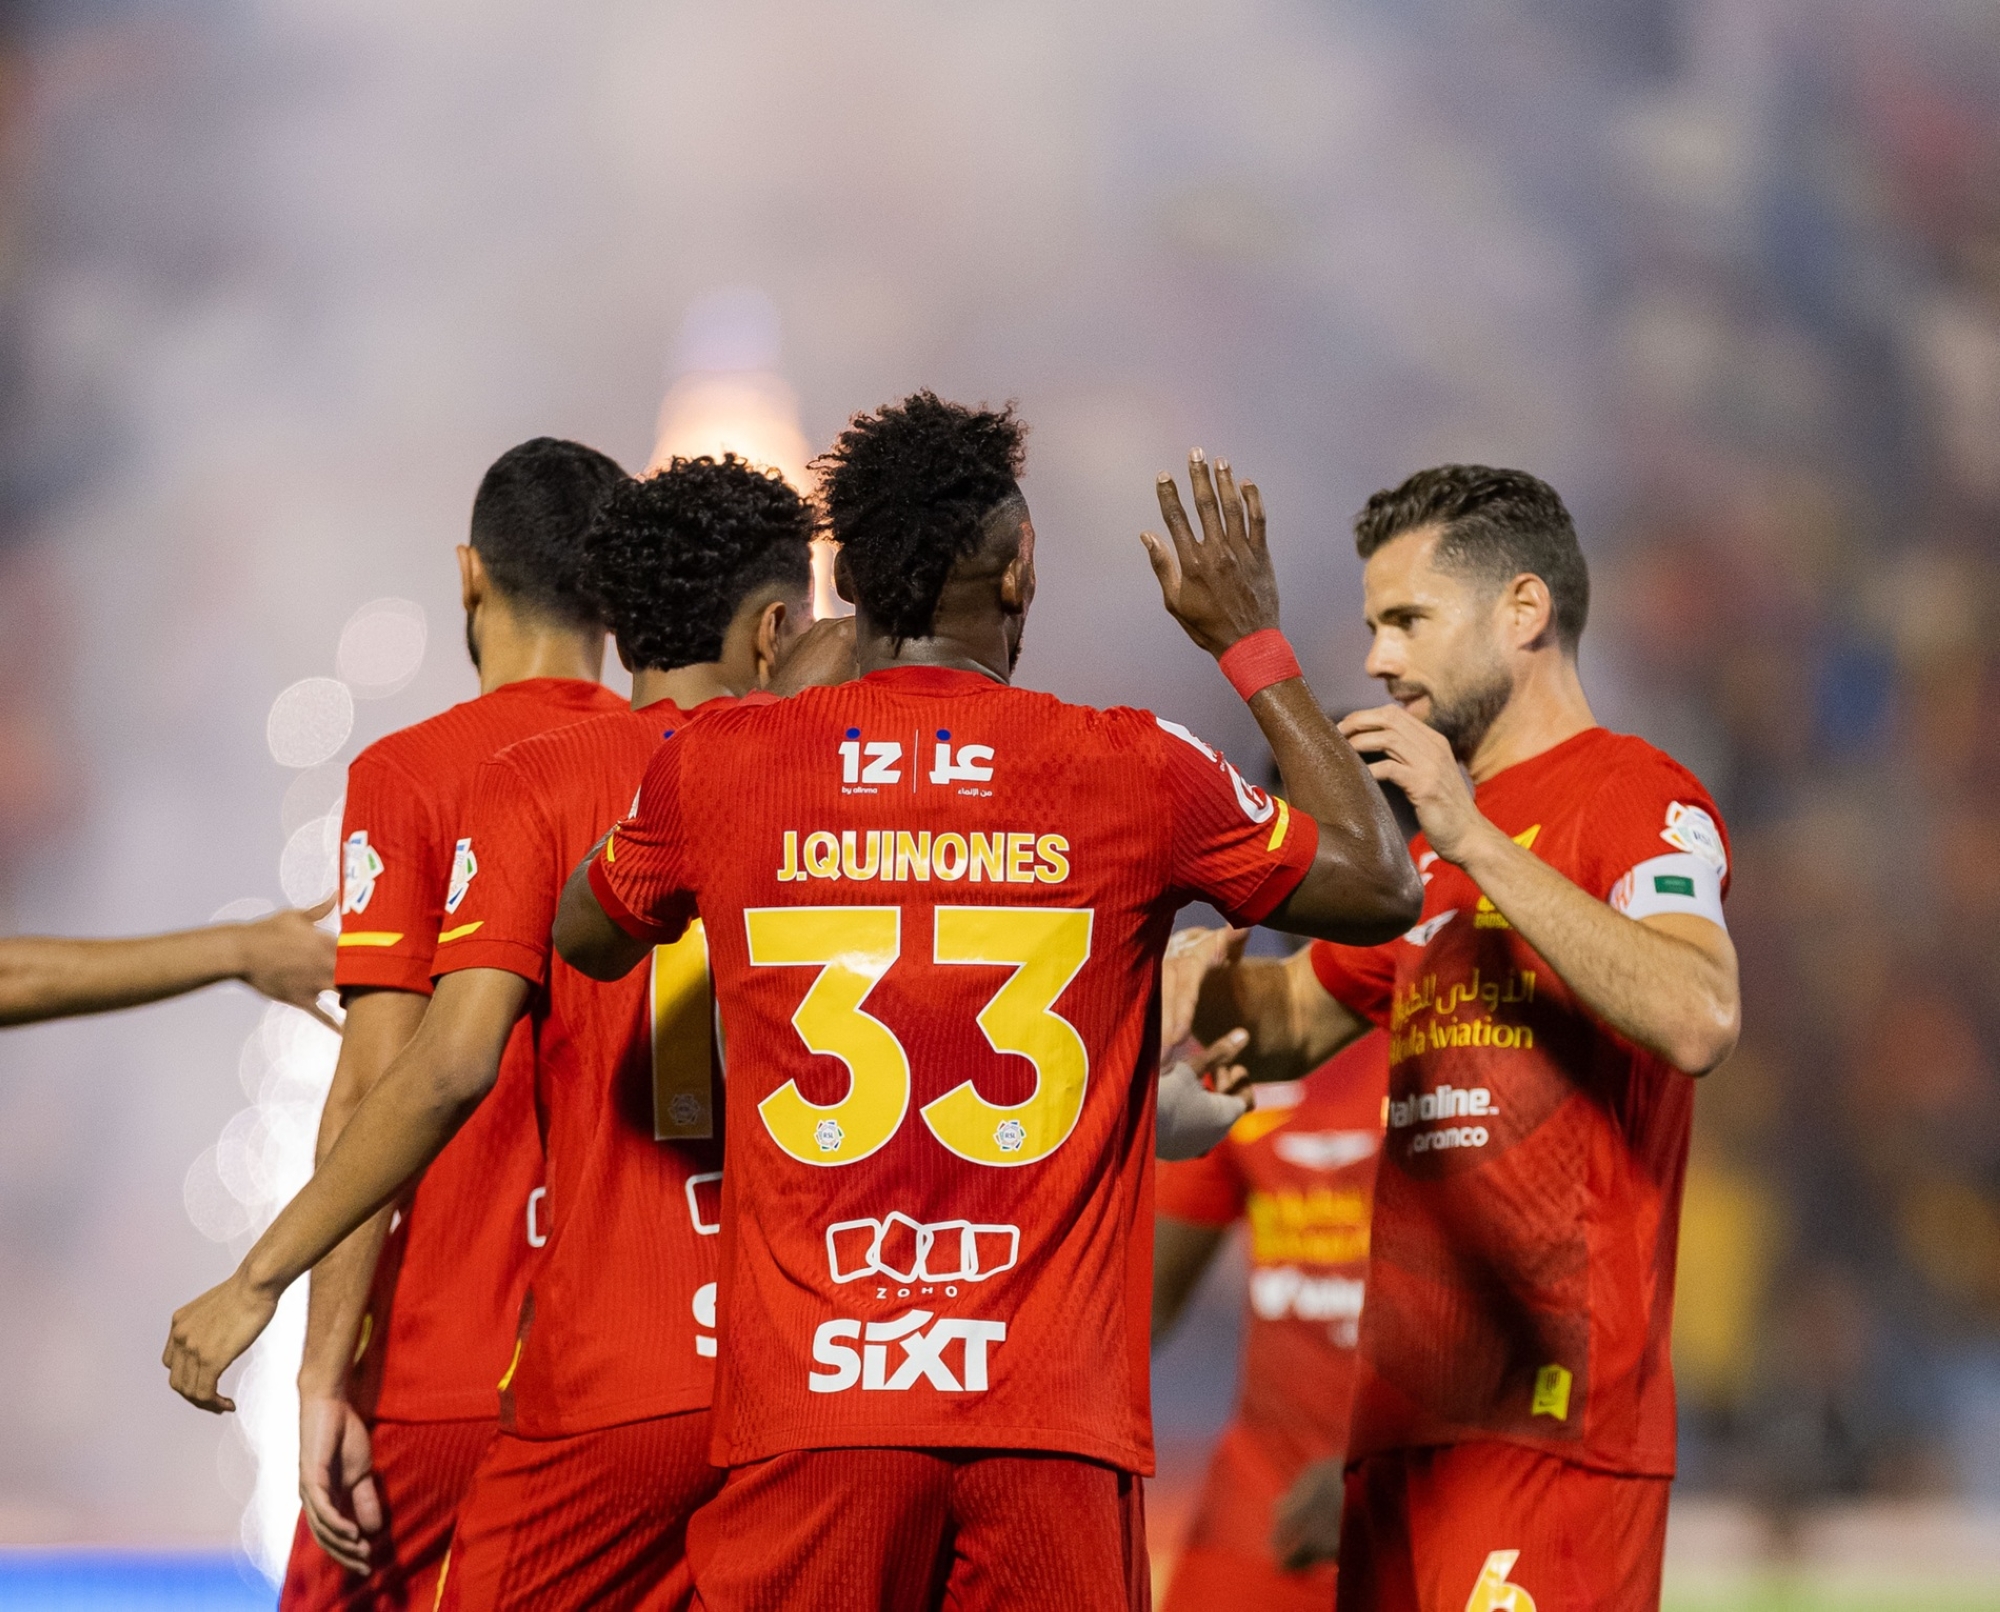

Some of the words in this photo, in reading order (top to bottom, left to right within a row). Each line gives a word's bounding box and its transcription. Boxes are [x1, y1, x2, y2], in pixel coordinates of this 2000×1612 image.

[841, 787, 852, 795] by
[853, 786, 878, 794] alinma
[980, 789, 993, 797] من
[777, 830, 1070, 884] J.QUINONES
[744, 905, 1095, 1168] 33
[876, 1285, 958, 1299] ZOHO
